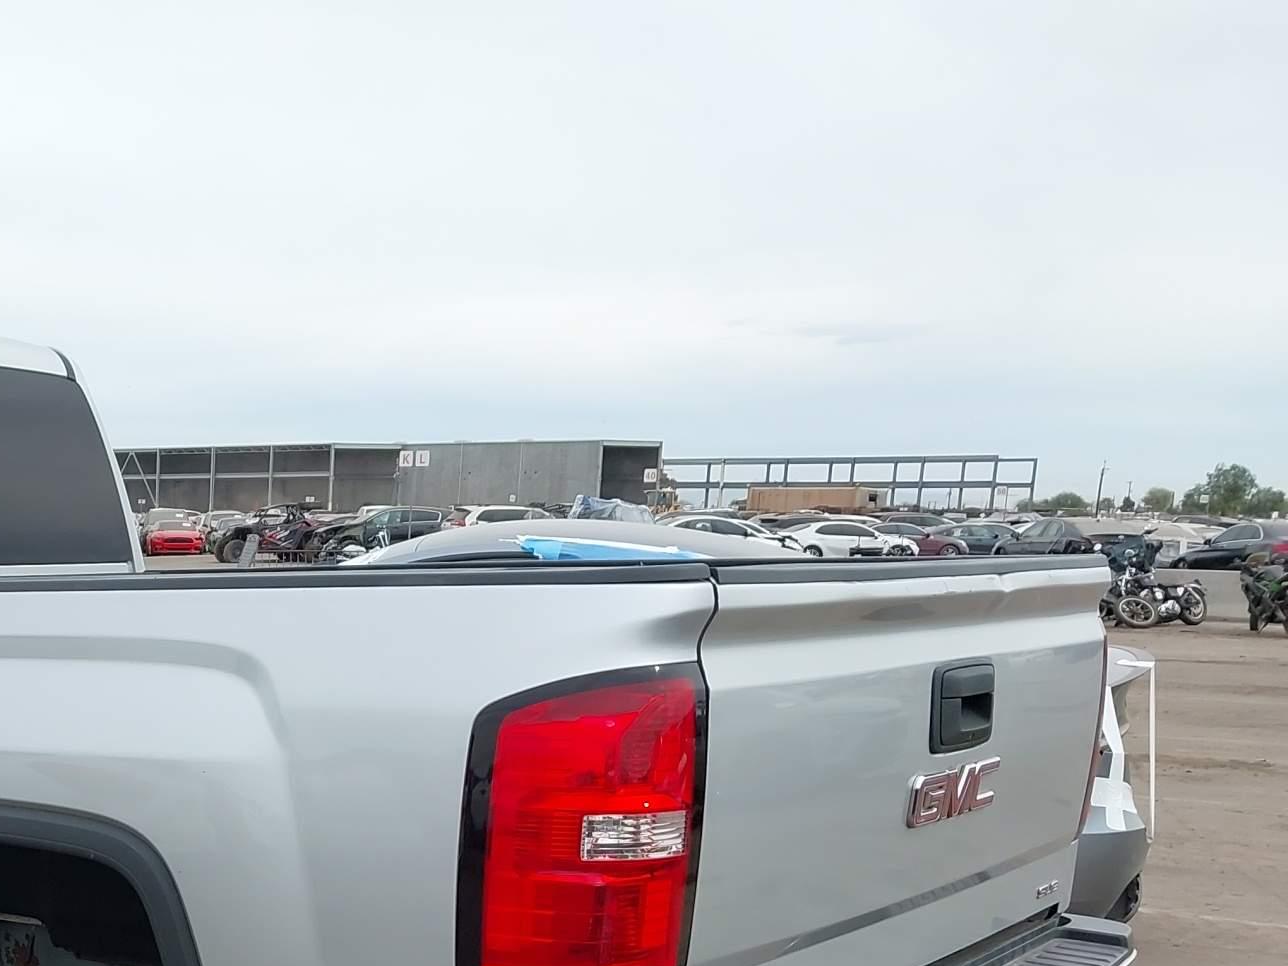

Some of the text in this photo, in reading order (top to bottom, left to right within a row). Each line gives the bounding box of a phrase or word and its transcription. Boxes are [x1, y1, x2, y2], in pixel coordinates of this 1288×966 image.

[402, 453, 426, 465] K L
[907, 756, 1001, 828] GMC
